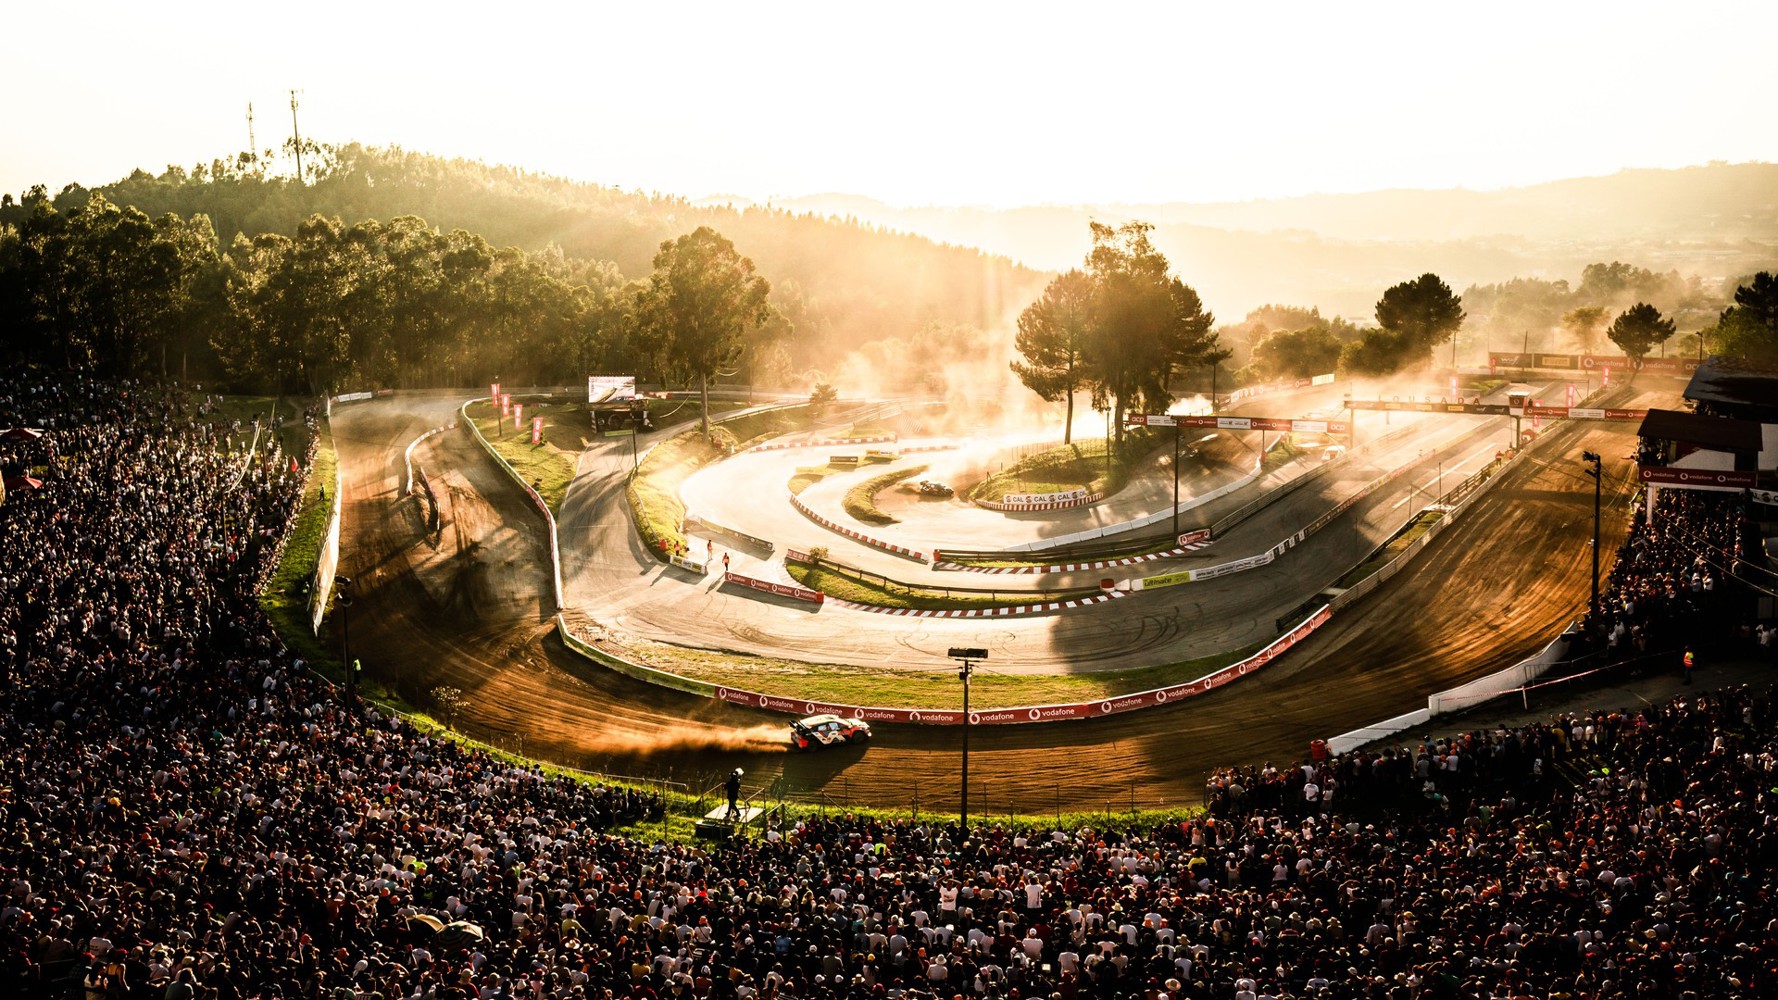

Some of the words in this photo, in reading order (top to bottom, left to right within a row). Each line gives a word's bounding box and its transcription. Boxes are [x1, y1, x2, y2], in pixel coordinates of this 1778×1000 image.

[727, 691, 749, 701] vodafone
[768, 699, 794, 709] vodafone
[815, 705, 843, 716] vodafone
[865, 711, 895, 719] vodafone
[921, 713, 954, 722] vodafone
[981, 713, 1015, 721] vodafone
[1041, 707, 1075, 717] vodafone
[1112, 697, 1142, 709] vodafone
[1211, 671, 1232, 685] vodafone
